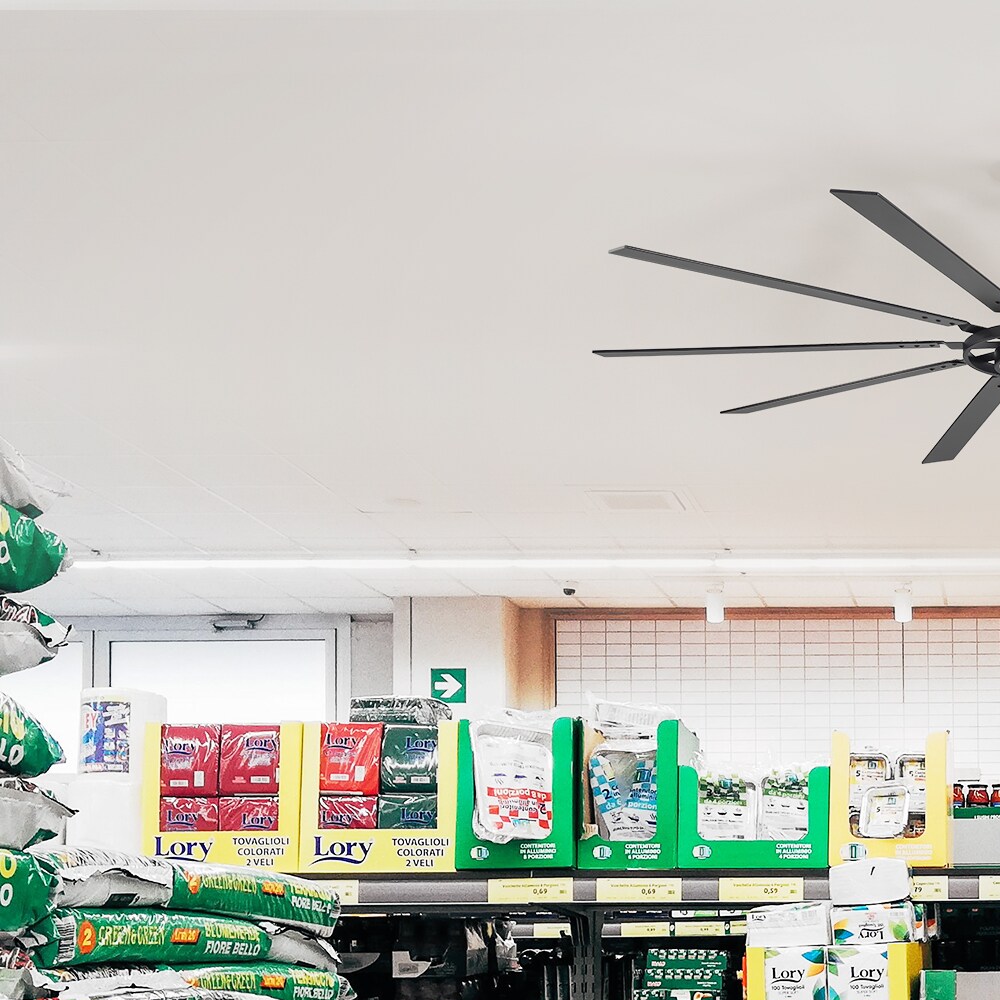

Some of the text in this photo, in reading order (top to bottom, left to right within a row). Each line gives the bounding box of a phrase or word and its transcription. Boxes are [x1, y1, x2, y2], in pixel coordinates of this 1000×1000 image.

[326, 733, 358, 750] Lory
[168, 811, 200, 826] Lory
[242, 814, 275, 829] Lory
[401, 808, 434, 825] Lory
[155, 836, 213, 862] Lory
[232, 837, 290, 846] TOVAGLIOLI
[392, 838, 449, 847] TOVAGLIOLI
[237, 848, 284, 856] COLORATI
[313, 836, 373, 864] Lory
[533, 888, 548, 896] 0,69
[642, 888, 656, 896] 0,69
[83, 928, 92, 946] 2
[98, 926, 166, 946] GREEN&GREEN
[205, 941, 260, 956] FIORE BELLO
[772, 967, 805, 984] Lory
[850, 966, 884, 983] Lory
